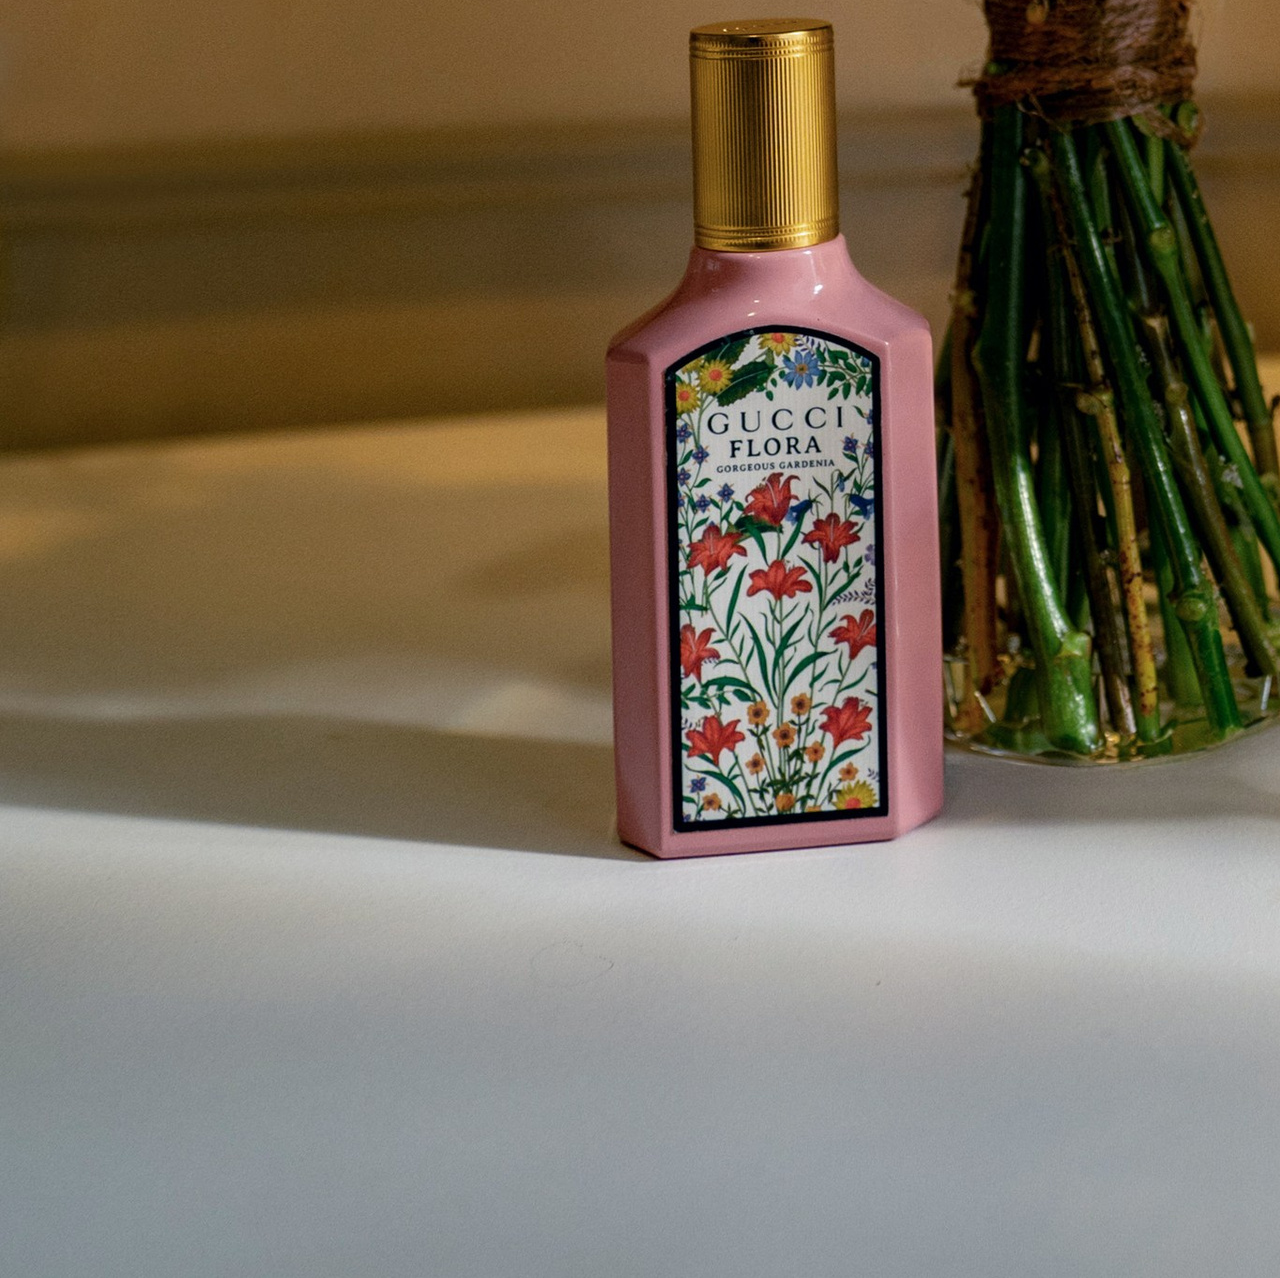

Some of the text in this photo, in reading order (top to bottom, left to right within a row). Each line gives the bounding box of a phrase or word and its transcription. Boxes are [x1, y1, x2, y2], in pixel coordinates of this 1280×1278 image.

[707, 406, 843, 434] GUCCI
[729, 436, 822, 458] FLORA
[716, 459, 836, 474] GORGEOUS GARDENIA
